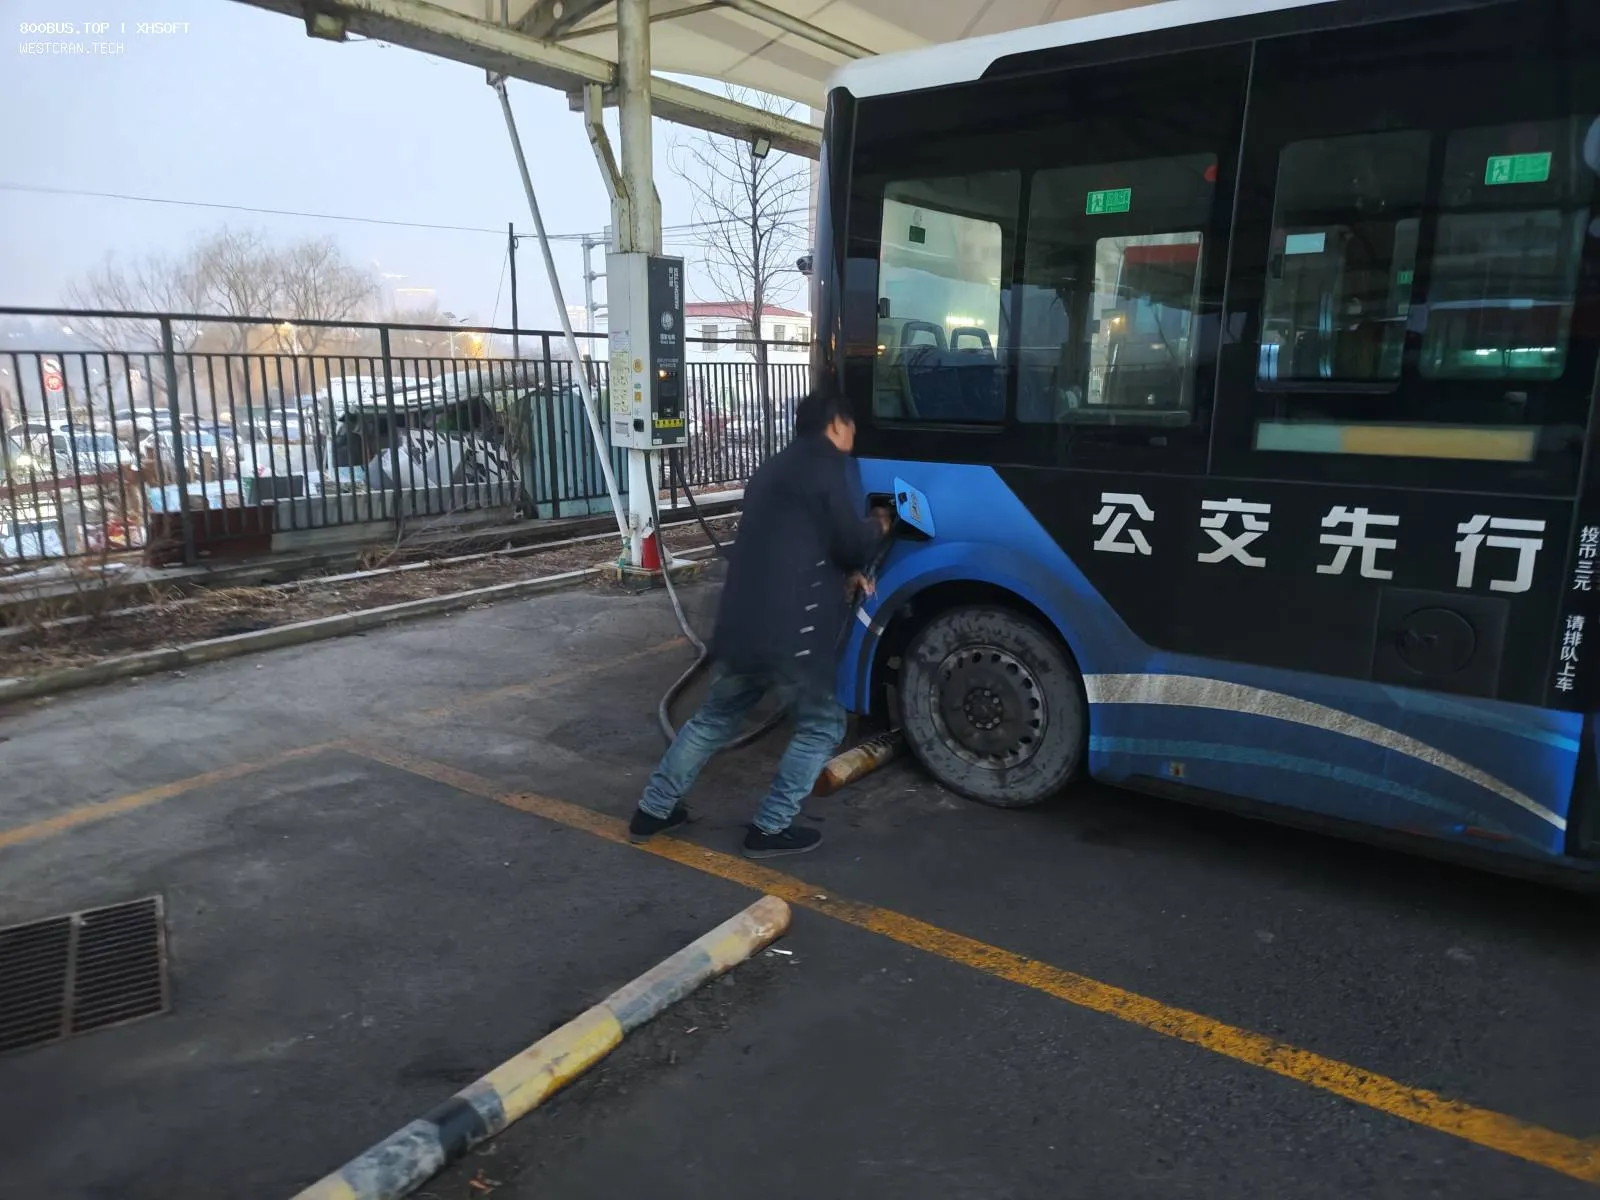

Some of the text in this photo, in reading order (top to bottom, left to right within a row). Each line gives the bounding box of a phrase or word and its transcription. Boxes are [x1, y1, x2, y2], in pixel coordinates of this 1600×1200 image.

[1092, 492, 1546, 593] 公交先行
[1554, 525, 1600, 692] 投币三元 请排队上车
